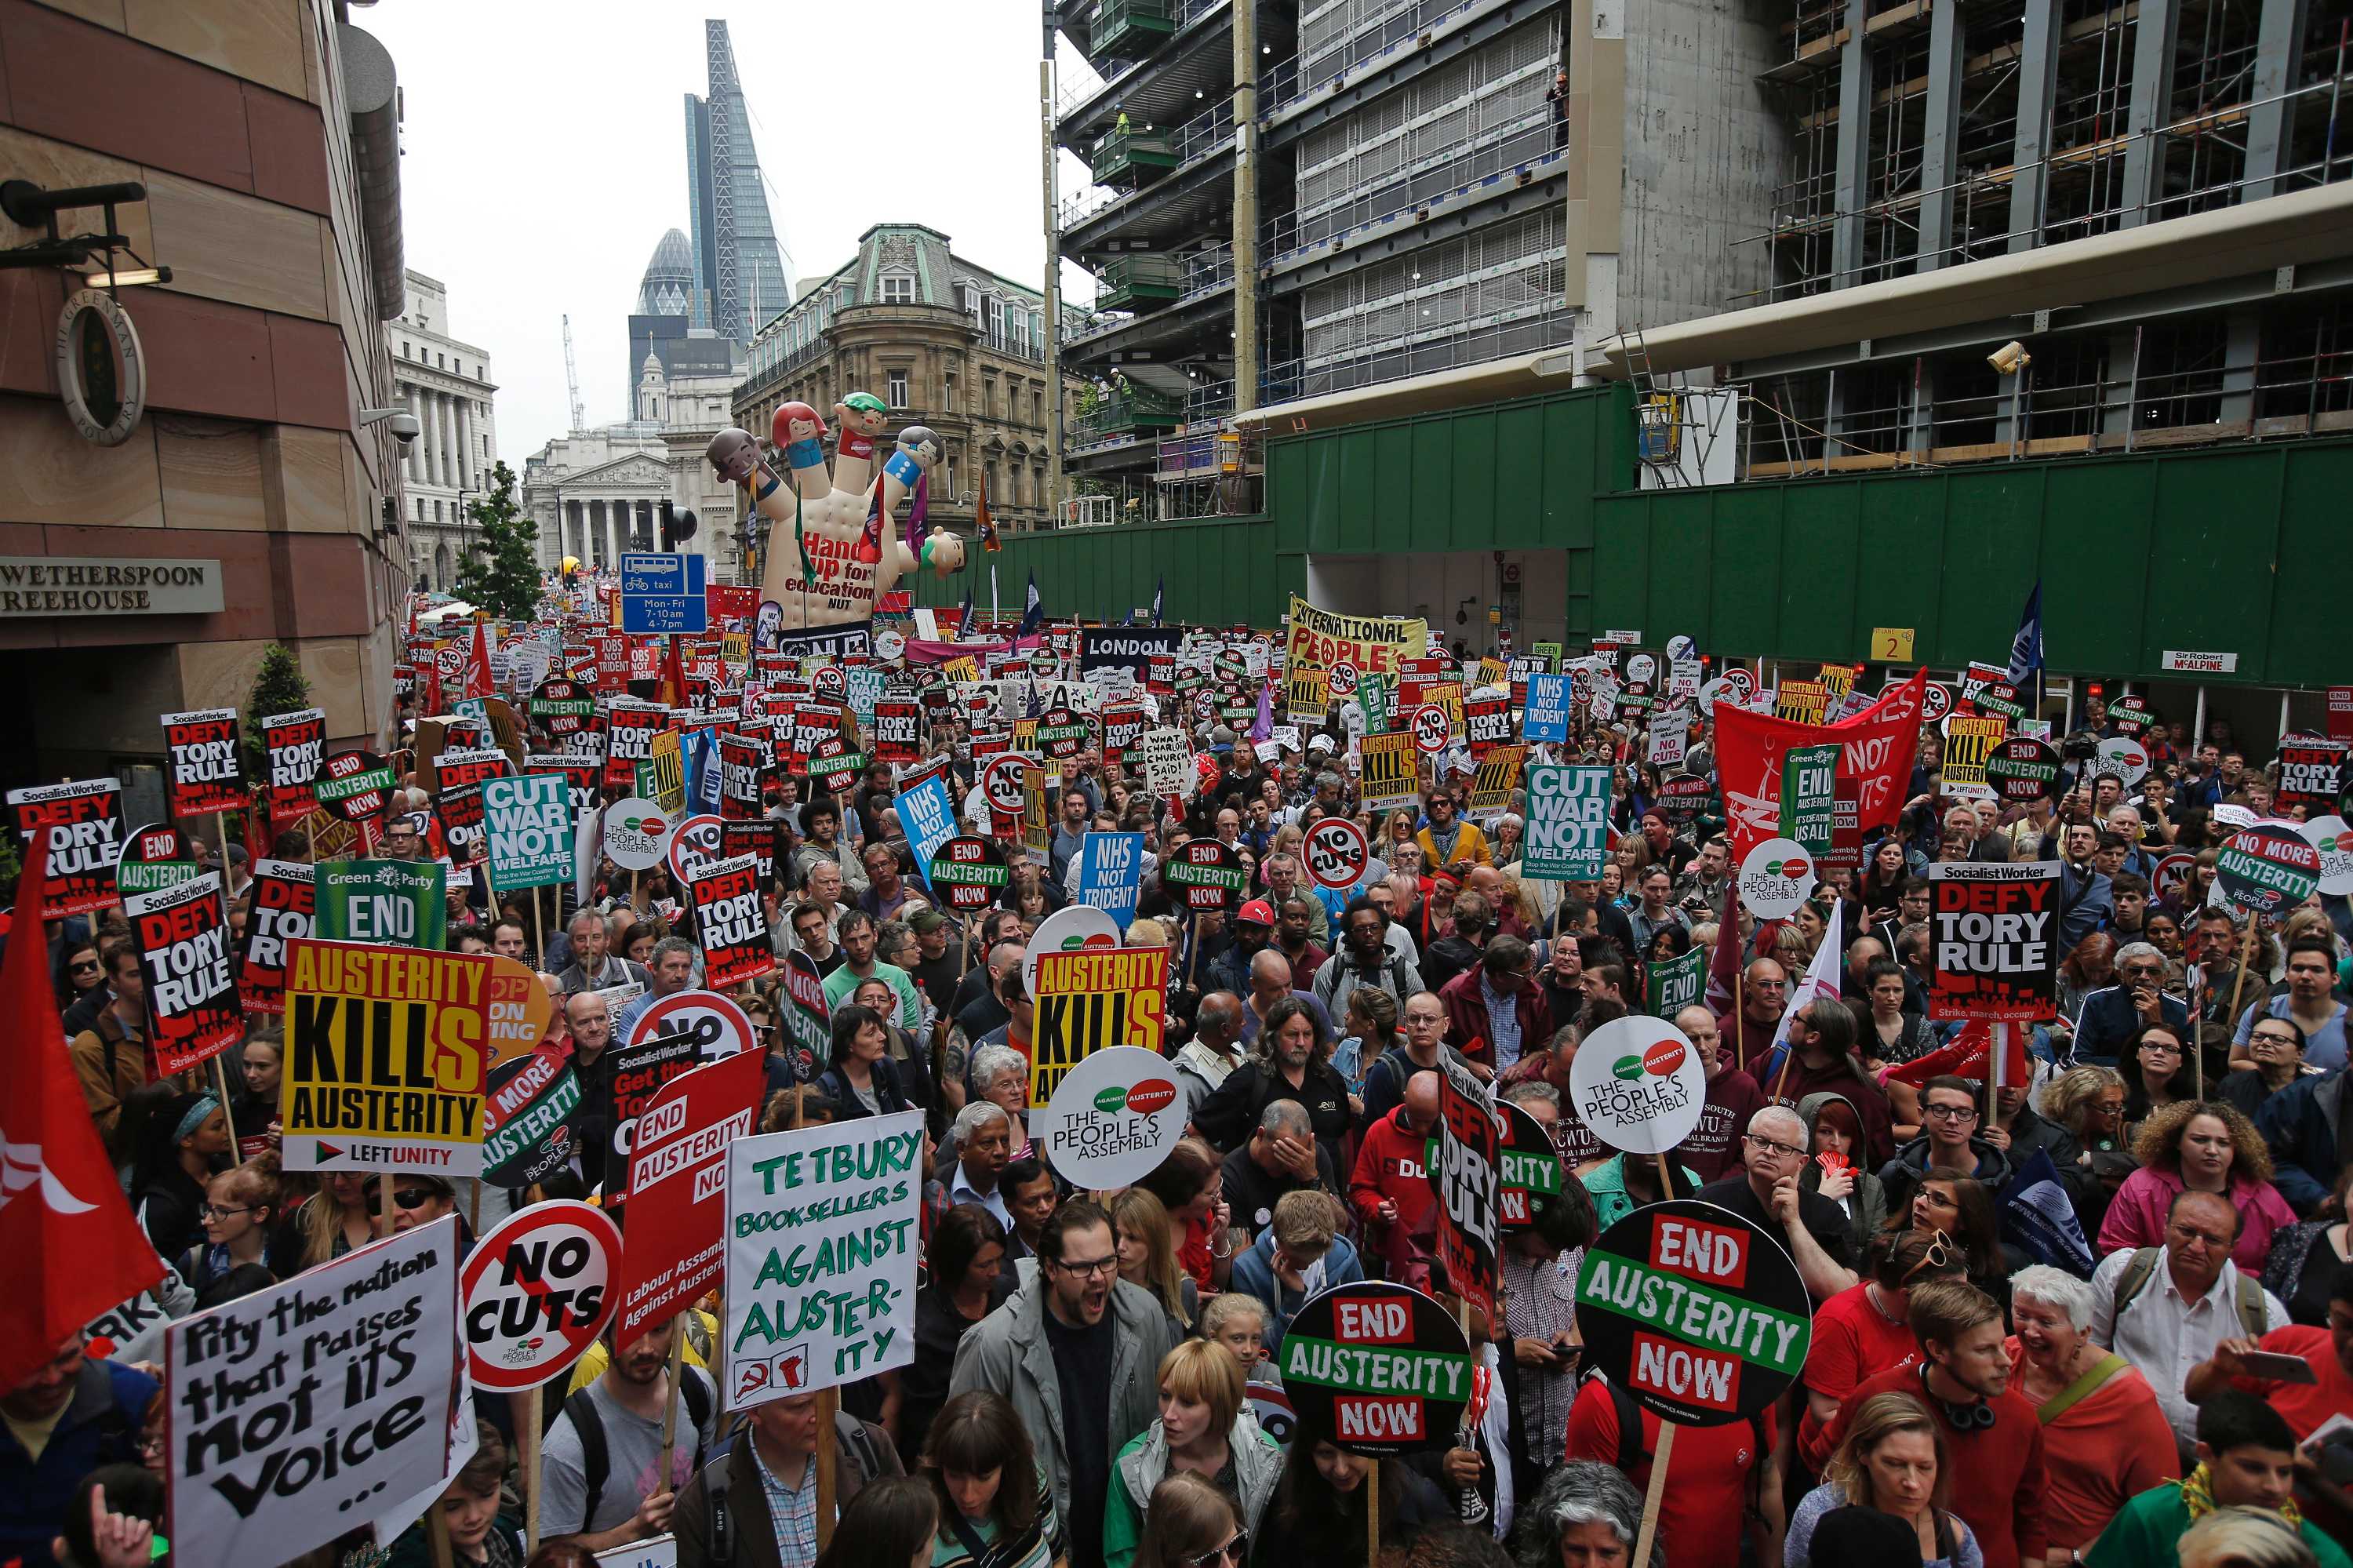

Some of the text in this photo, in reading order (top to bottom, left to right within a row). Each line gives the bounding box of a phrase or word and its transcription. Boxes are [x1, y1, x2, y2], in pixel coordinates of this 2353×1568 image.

[0, 565, 205, 587] WETHERSPOON
[810, 555, 872, 581] up for
[653, 580, 672, 589] taxi
[785, 577, 875, 600] education
[646, 609, 668, 618] 7-10
[827, 598, 851, 610] NUT
[649, 620, 682, 630] 4-7 pm
[1293, 602, 1408, 642] INTERNATIONAL
[602, 638, 623, 653] JOBS
[604, 652, 621, 660] NOT
[1090, 638, 1169, 657] LONDON
[1886, 638, 1898, 657] 2
[598, 661, 629, 673] TRIDENT
[1293, 668, 1331, 682] AUSTERITY
[547, 684, 570, 698] END
[1290, 681, 1328, 703] KILLS
[1536, 678, 1563, 698] NHS
[533, 700, 591, 714] AUSTERITY
[877, 704, 916, 717] DEFY
[1223, 708, 1257, 718] AUSTERITY
[1232, 697, 1246, 707] END
[1537, 696, 1560, 709] NOT
[551, 716, 578, 731] NOW
[877, 716, 916, 729] TORY
[1233, 719, 1249, 729] NOW
[1529, 708, 1566, 725] TRIDENT
[169, 720, 232, 744] DEFY
[877, 729, 916, 742] RULE
[1149, 734, 1180, 744] WHAT
[1362, 732, 1417, 753] AUSTERITY
[171, 739, 235, 765] TORY
[1146, 751, 1187, 763] CHURCH
[1652, 749, 1680, 762] CUTS
[1659, 739, 1676, 751] NO
[2010, 744, 2037, 759] END
[2284, 748, 2343, 766] DEFY
[176, 758, 239, 784] RULE
[332, 756, 360, 778] END
[1362, 748, 1417, 784] KILLS
[1988, 758, 2057, 780] AUSTERITY
[2281, 763, 2341, 780] TORY
[318, 770, 390, 800] AUSTERITY
[486, 776, 563, 809] CUT
[1363, 777, 1417, 798] AUSTERITY
[1532, 769, 1609, 798] CUT
[1798, 767, 1831, 797] END
[2007, 781, 2038, 795] NOW
[2281, 777, 2340, 794] RULE
[345, 791, 380, 816] NOW
[904, 784, 940, 824] NHS
[1531, 797, 1606, 822] WAR
[1797, 796, 1831, 809] AUSTERITY
[488, 802, 568, 833] WAR
[609, 824, 627, 835] THE
[918, 813, 944, 839] NOT
[490, 825, 569, 860] NOT
[605, 833, 657, 846] PEOPLE'S
[916, 824, 958, 864] TRIDENT
[1313, 830, 1349, 849] NO
[1529, 820, 1604, 849] NOT
[493, 851, 572, 871] WELFARE
[615, 844, 659, 854] ASSEMBLY
[1096, 837, 1131, 871] NHS
[1191, 846, 1219, 863] END
[1311, 847, 1362, 872] CUTS
[1526, 847, 1602, 861] WELFARE
[2235, 834, 2314, 865] NO MORE
[696, 857, 751, 879] Socialist Worker
[1097, 868, 1128, 888] NOT
[1169, 864, 1241, 890] AUSTERITY
[1944, 866, 2046, 880] Socialist Worker
[2218, 850, 2316, 898] AUSTERITY
[327, 872, 435, 890] Green Party
[695, 868, 758, 904] DEFY
[144, 881, 212, 911] Socialist Worker
[698, 890, 760, 927] TORY
[1084, 886, 1135, 910] TRIDENT
[1190, 888, 1222, 905] NOW
[1937, 881, 2052, 912] DEFY
[140, 894, 218, 950] DEFY
[349, 894, 415, 939] END
[1937, 911, 2051, 941] TORY
[704, 913, 766, 951] RULE
[144, 925, 223, 983] TORY
[1938, 942, 2046, 972] RULE
[293, 946, 486, 1006] AUSTERITY
[1039, 951, 1164, 994] AUSTERITY
[154, 955, 232, 1017] RULE
[1938, 1009, 2035, 1020] Strike, march, occupy
[293, 993, 482, 1093] KILLS
[1615, 1047, 1684, 1074] AGAINST AUSTERITY
[1096, 1089, 1174, 1105] AGAINST AUSTERITY
[1584, 1075, 1684, 1121] PEOPLE'S
[1588, 1079, 1624, 1100] THE
[291, 1086, 479, 1137] AUSTERITY
[640, 1101, 684, 1143] END
[1063, 1110, 1099, 1129] THE
[1615, 1091, 1689, 1128] ASSEMBLY
[1053, 1115, 1158, 1151] PEOPLE'S
[636, 1111, 751, 1189] AUSTERITY
[1077, 1133, 1162, 1161] ASSEMBLY
[735, 1179, 908, 1239] BOOKSELLERS
[752, 1217, 915, 1290] AGAINST
[1660, 1221, 1740, 1276] END
[500, 1237, 591, 1286] NO
[627, 1271, 673, 1307] Labour
[185, 1246, 438, 1367] Pity the nation
[467, 1285, 605, 1344] CUTS
[624, 1292, 675, 1330] Against
[733, 1278, 902, 1355] AUSTER-
[1585, 1259, 1801, 1365] AUSTERITY
[1340, 1303, 1406, 1337] END
[182, 1294, 424, 1424] that raises
[835, 1327, 896, 1377] ITY
[1289, 1343, 1464, 1395] AUSTERITY
[1636, 1343, 1733, 1402] NOW
[186, 1377, 322, 1478] not
[1340, 1402, 1418, 1436] NOW
